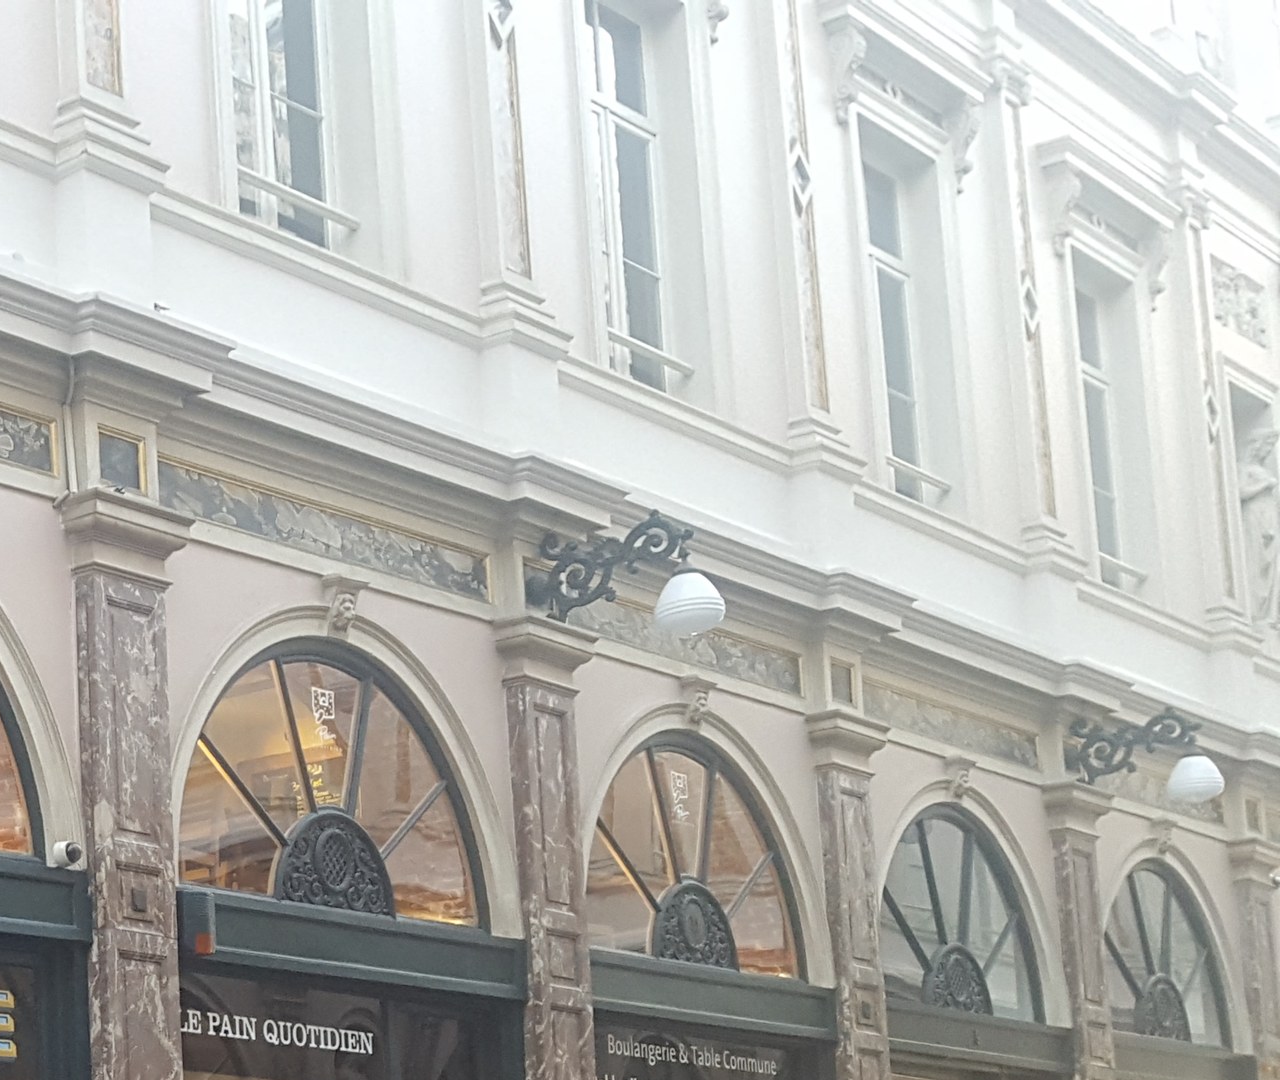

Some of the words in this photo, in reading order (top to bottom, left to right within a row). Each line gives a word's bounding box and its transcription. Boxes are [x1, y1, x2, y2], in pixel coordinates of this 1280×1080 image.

[207, 1012, 258, 1041] PAIN
[263, 1019, 374, 1055] QUOTIDIEN
[607, 1034, 677, 1066] Boulangerie
[678, 1043, 689, 1064] &
[690, 1045, 722, 1068] Table
[723, 1051, 777, 1075] Commune
